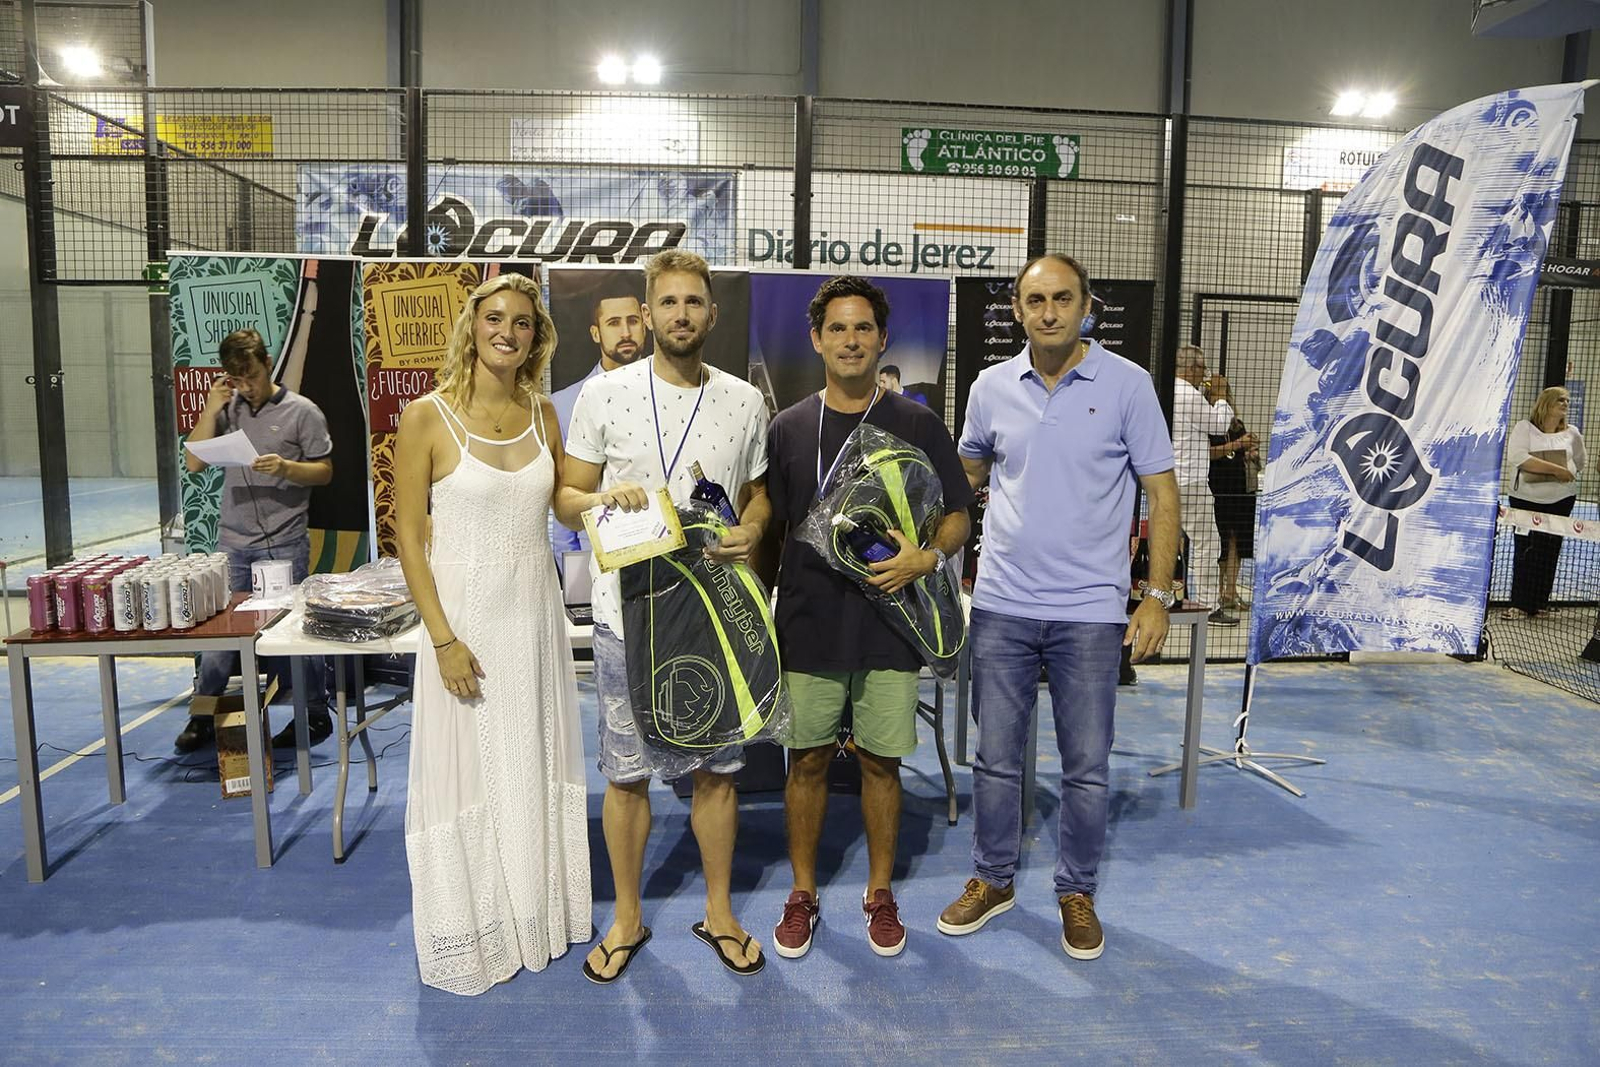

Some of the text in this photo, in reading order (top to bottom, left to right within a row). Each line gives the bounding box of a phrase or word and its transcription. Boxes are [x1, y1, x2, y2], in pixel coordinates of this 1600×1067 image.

[939, 130, 992, 142] CLÍNICA
[996, 135, 1021, 145] DEL
[937, 143, 1046, 163] ATLÁNTICO
[1340, 151, 1382, 166] ROTUL
[962, 163, 1037, 177] 956 30 69 05
[860, 228, 903, 266] de
[910, 234, 995, 274] Jerez
[1547, 264, 1590, 276] HOGAR
[203, 291, 260, 315] UNUSUAL
[393, 294, 446, 318] UNUSUAL
[394, 322, 447, 346] SHERRIES
[1330, 143, 1465, 572] LOCURA
[371, 371, 429, 400] ¿FUEGO?
[181, 392, 211, 412] CUA
